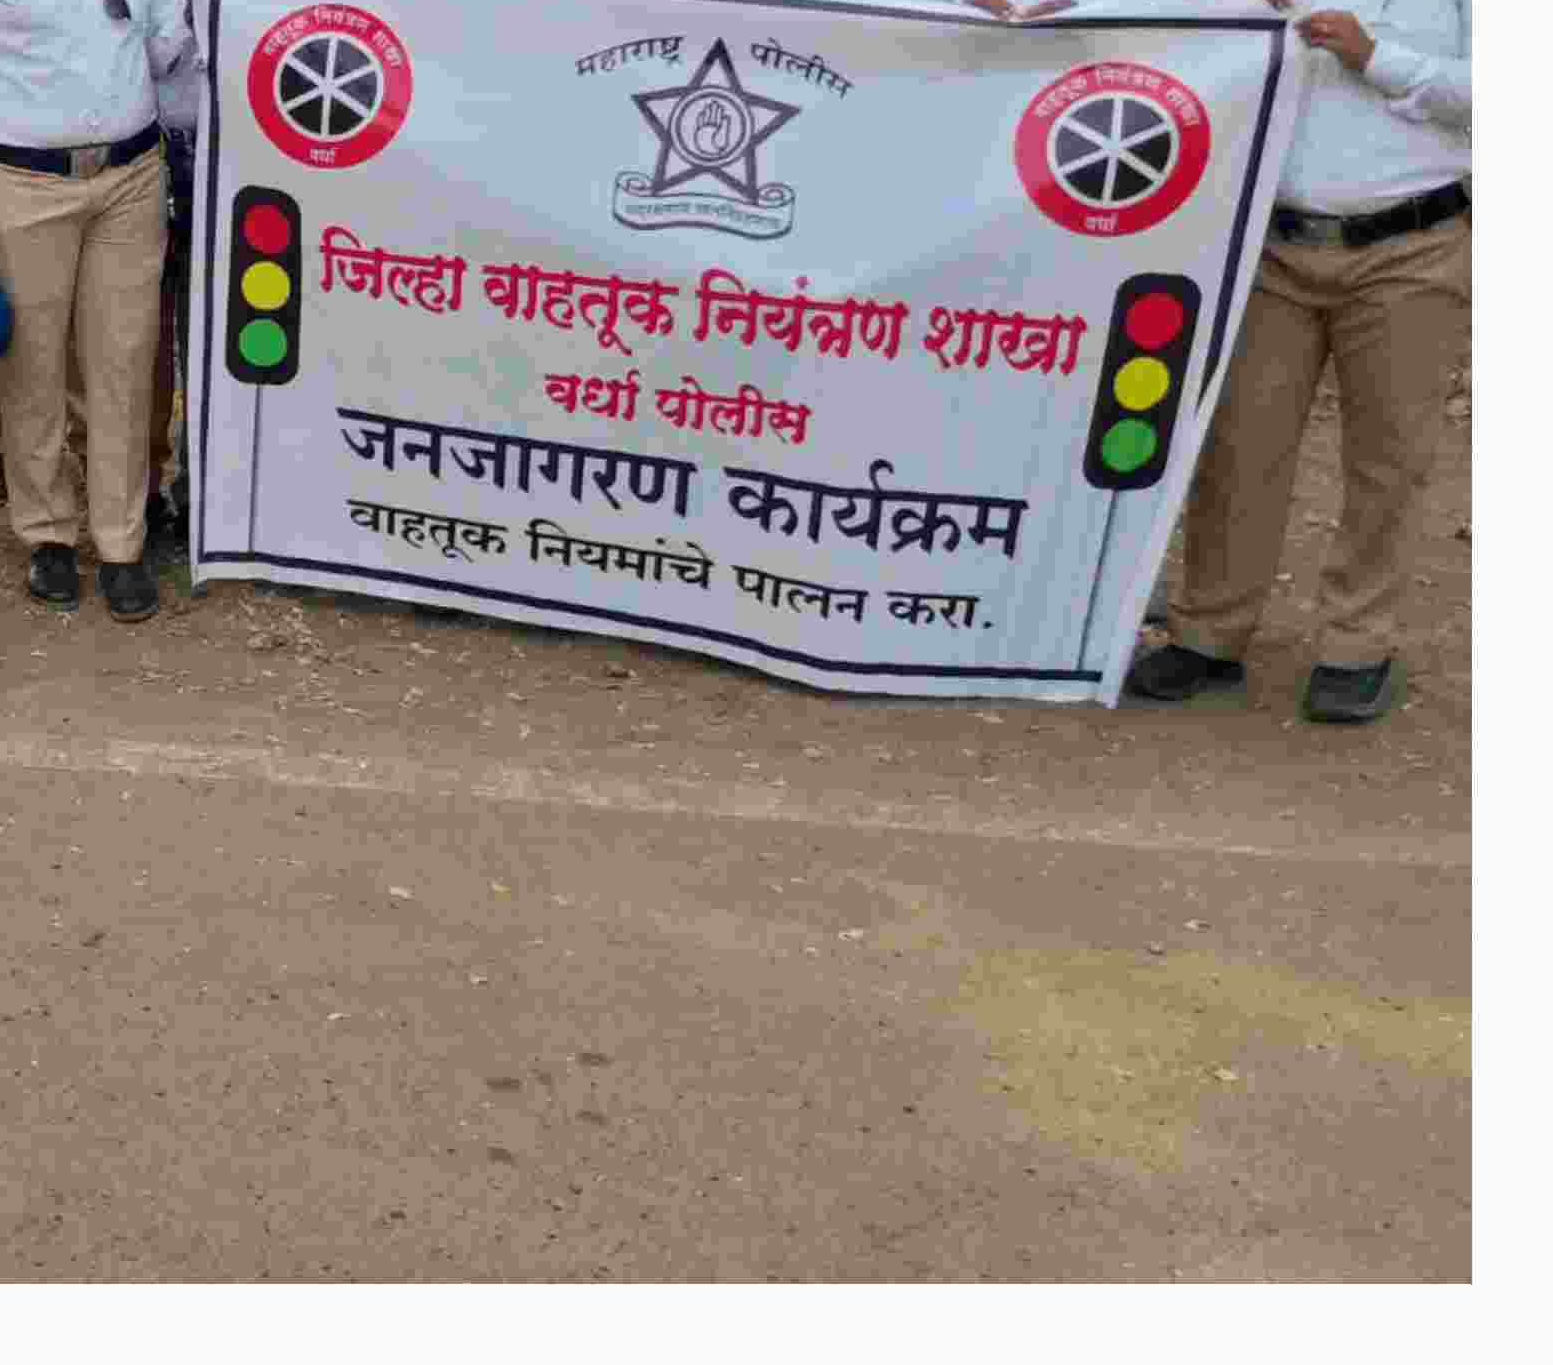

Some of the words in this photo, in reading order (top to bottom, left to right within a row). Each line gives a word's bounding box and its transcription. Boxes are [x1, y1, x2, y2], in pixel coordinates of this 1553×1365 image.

[575, 34, 687, 75] महाराष्ट्र
[749, 36, 855, 99] पोलीस
[320, 228, 466, 312] जिल्हा
[483, 264, 678, 353] वाहतूक
[696, 267, 908, 357] नियंत्रण
[922, 306, 1087, 374] शाखा
[544, 366, 638, 421] वर्धा
[655, 375, 813, 444] पोलीस
[337, 407, 697, 517] जनजागरण
[724, 460, 1028, 559] कार्यक्रम
[347, 498, 507, 561] वाहतूक
[525, 517, 714, 591] नियमांचे
[733, 563, 868, 621] पालन
[887, 590, 994, 630] करा.
